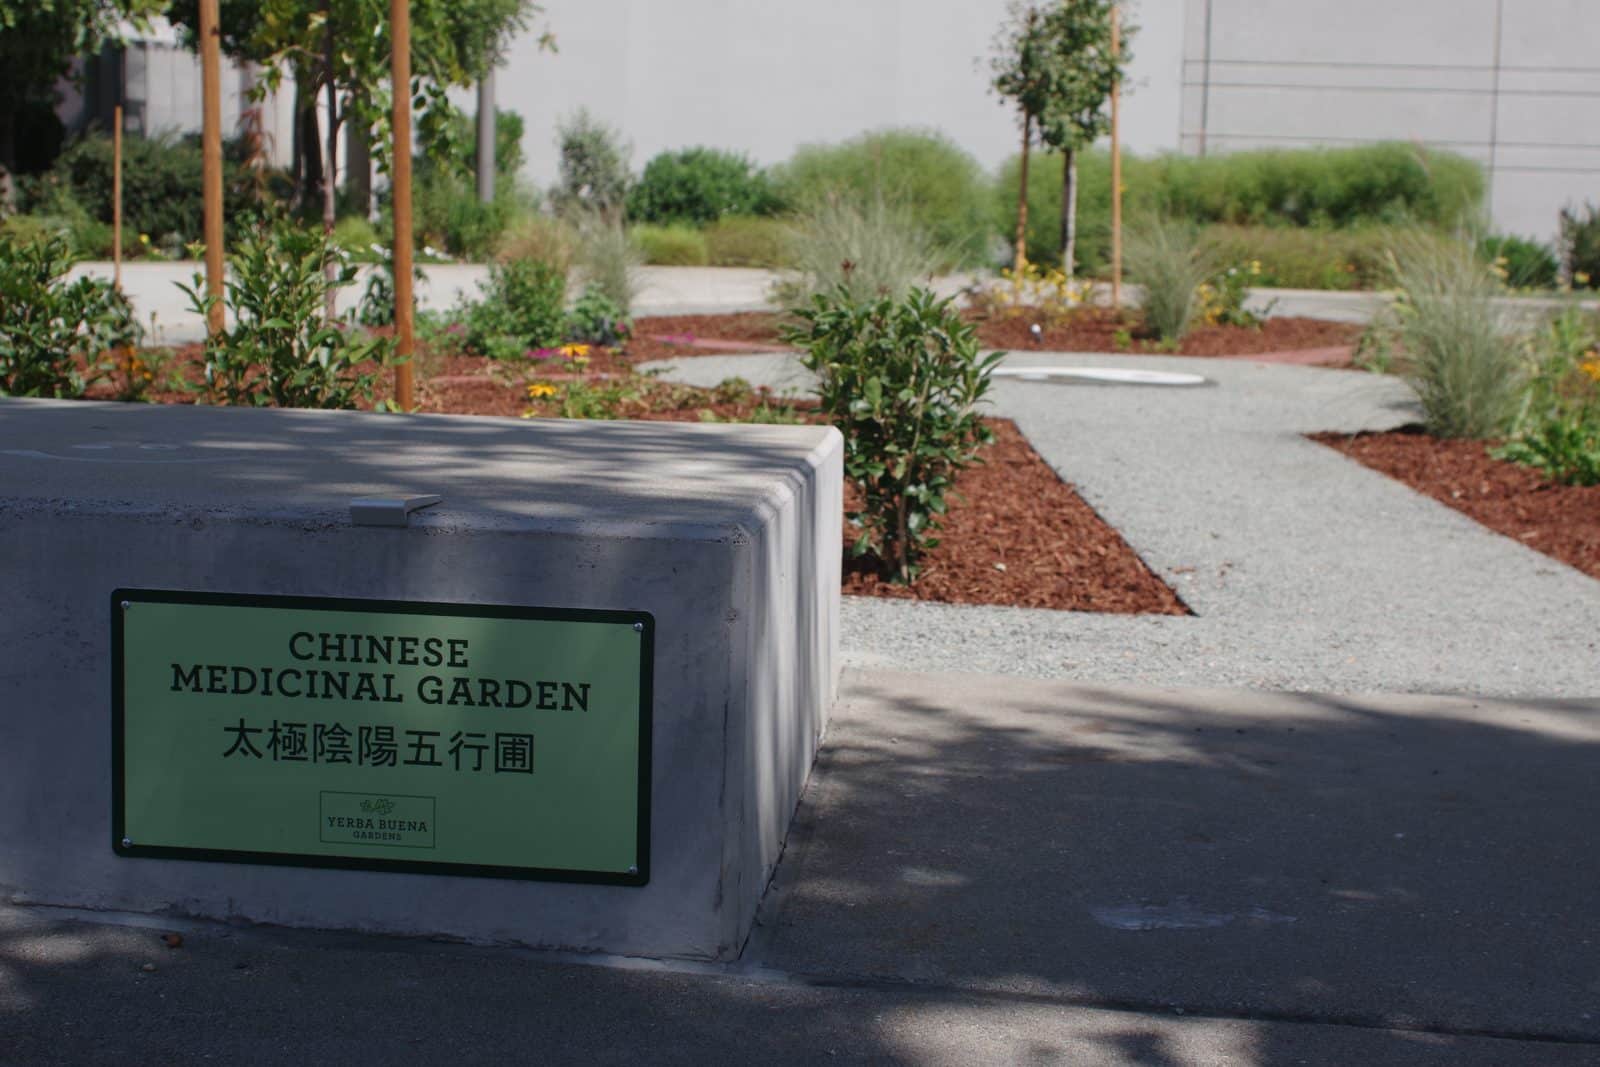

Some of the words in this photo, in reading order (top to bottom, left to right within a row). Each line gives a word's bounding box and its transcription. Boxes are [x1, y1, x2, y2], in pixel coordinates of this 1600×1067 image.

[289, 631, 469, 669] CHINESE
[170, 663, 405, 703] MEDICINAL
[416, 674, 592, 713] GARDEN
[222, 717, 535, 775] 太極陰陽五行圃
[327, 816, 375, 830] YERBA
[378, 818, 428, 833] BUENA
[352, 830, 402, 841] GARDENS
